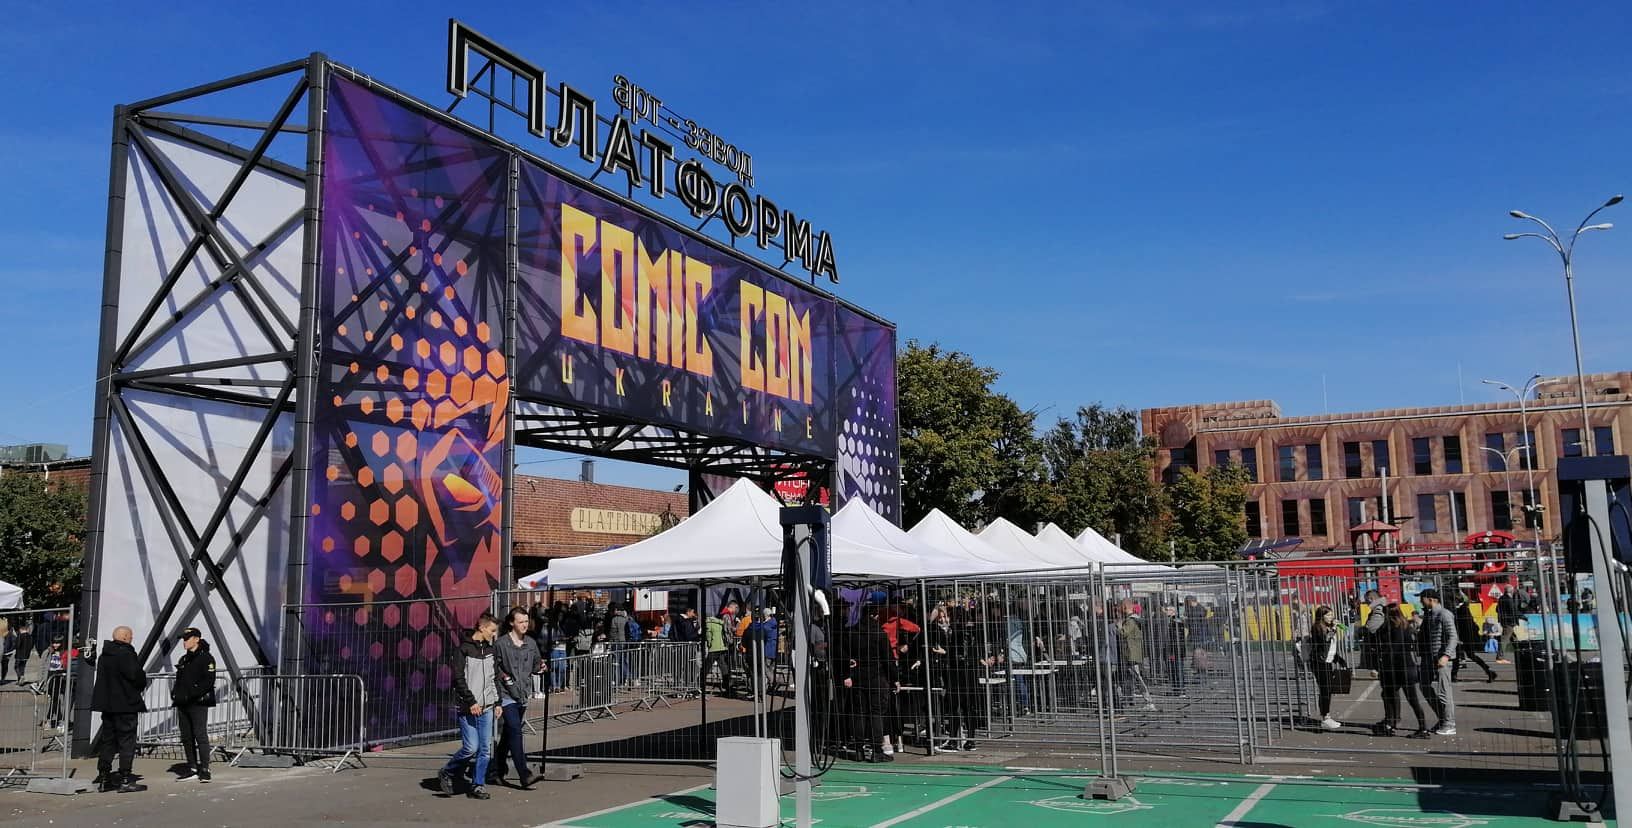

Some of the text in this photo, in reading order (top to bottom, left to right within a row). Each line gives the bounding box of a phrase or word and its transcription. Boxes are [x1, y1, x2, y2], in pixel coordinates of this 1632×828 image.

[447, 17, 839, 283] ПЛАТФОРМА
[561, 202, 812, 405] COMIC CON
[561, 354, 812, 439] UKRAINE
[579, 509, 657, 532] PLATFORMA
